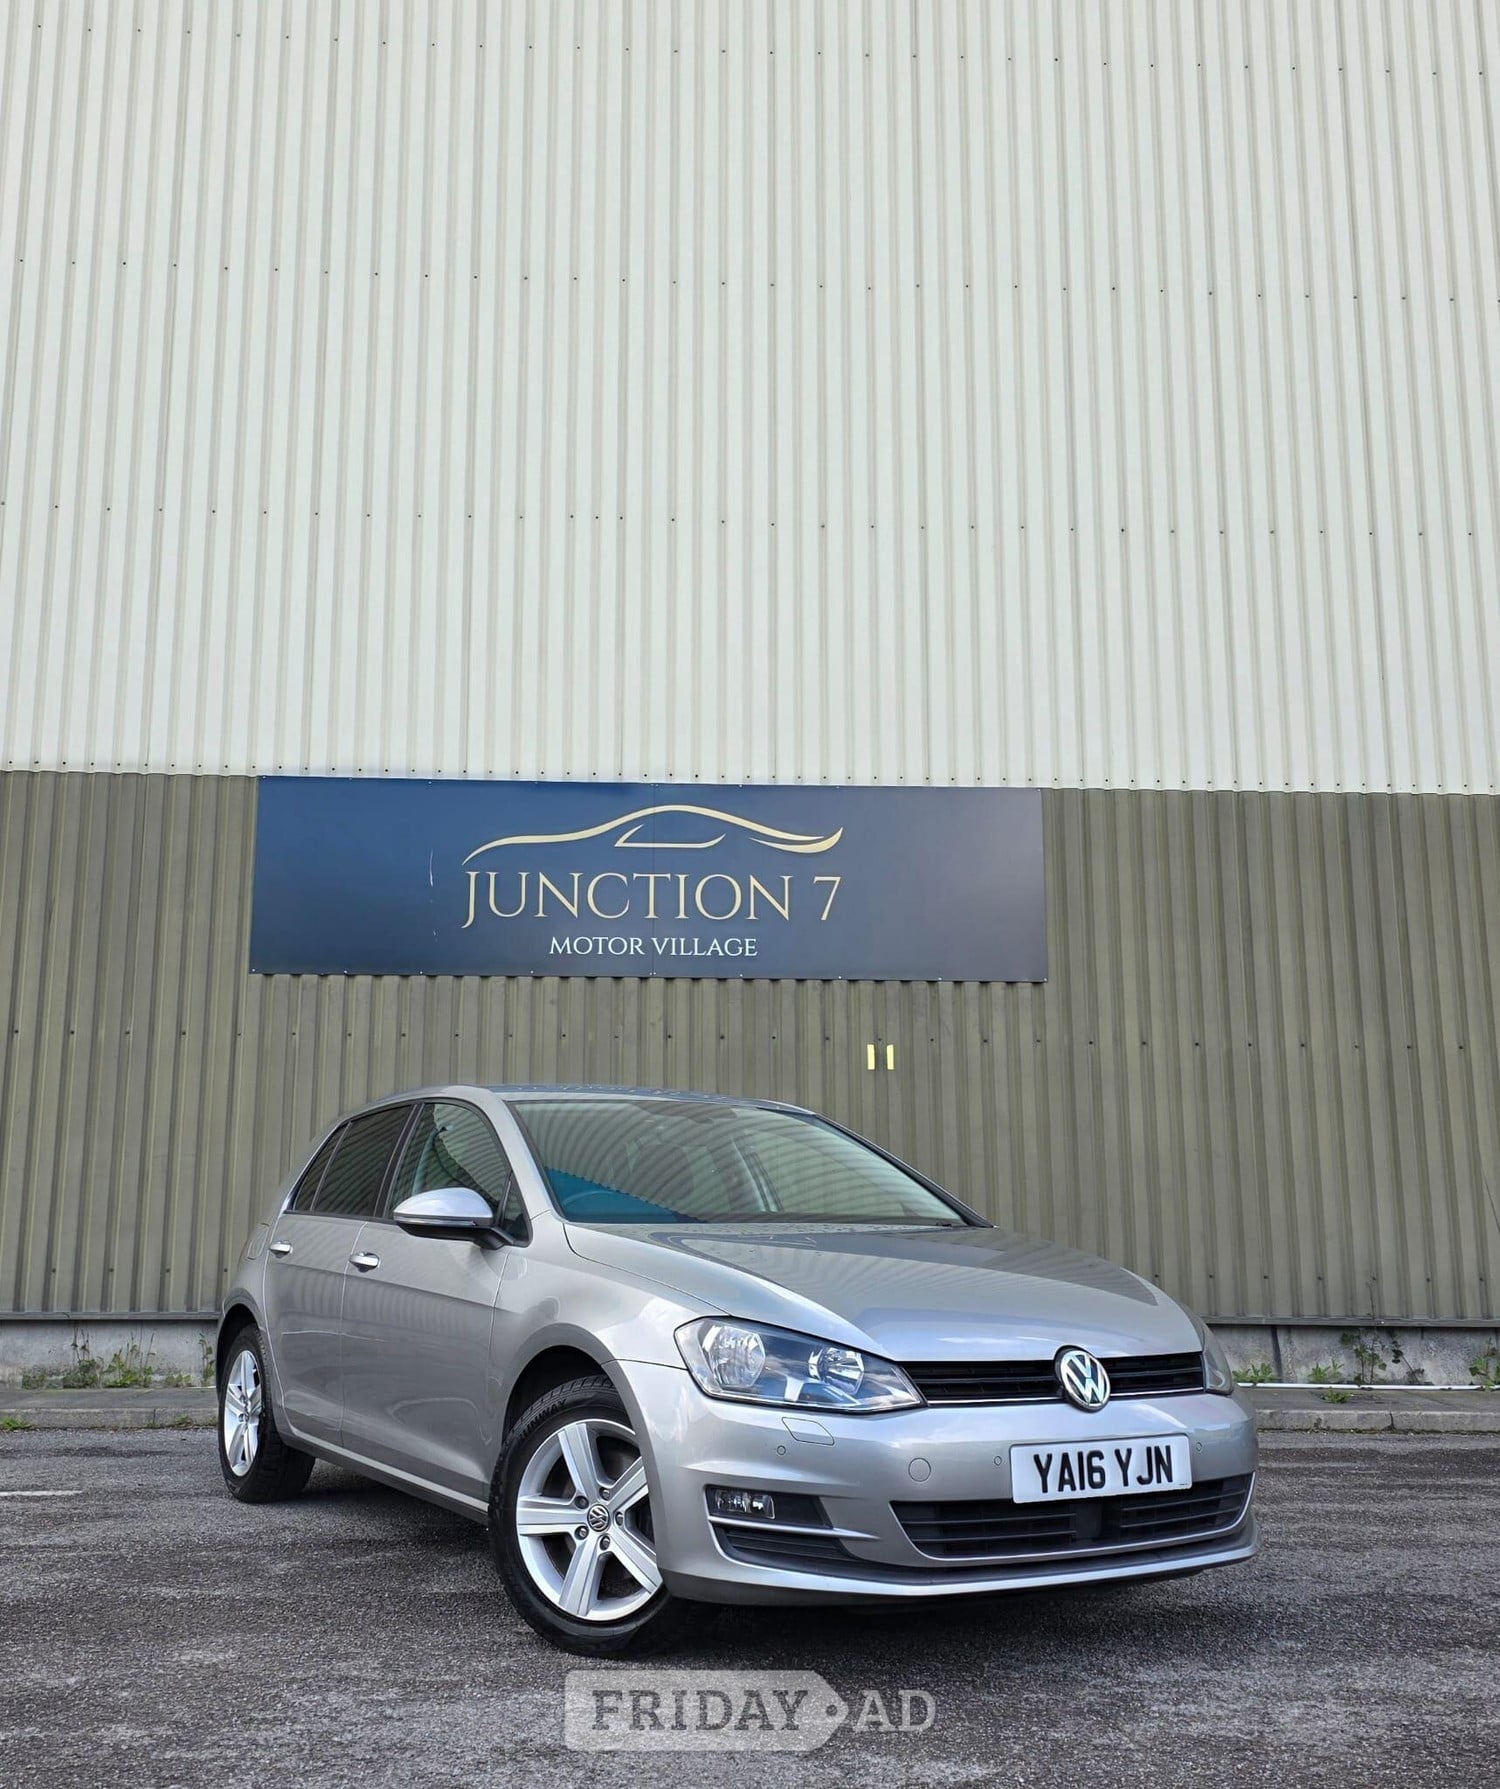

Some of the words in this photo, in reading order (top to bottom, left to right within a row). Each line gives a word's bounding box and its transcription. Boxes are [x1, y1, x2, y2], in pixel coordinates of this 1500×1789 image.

[461, 871, 793, 929] JUNCTION
[812, 875, 842, 921] 7
[549, 936, 646, 956] MOTOR
[650, 937, 758, 957] VILLAGE
[1033, 1449, 1106, 1494] YA16
[1114, 1445, 1173, 1487] YJN
